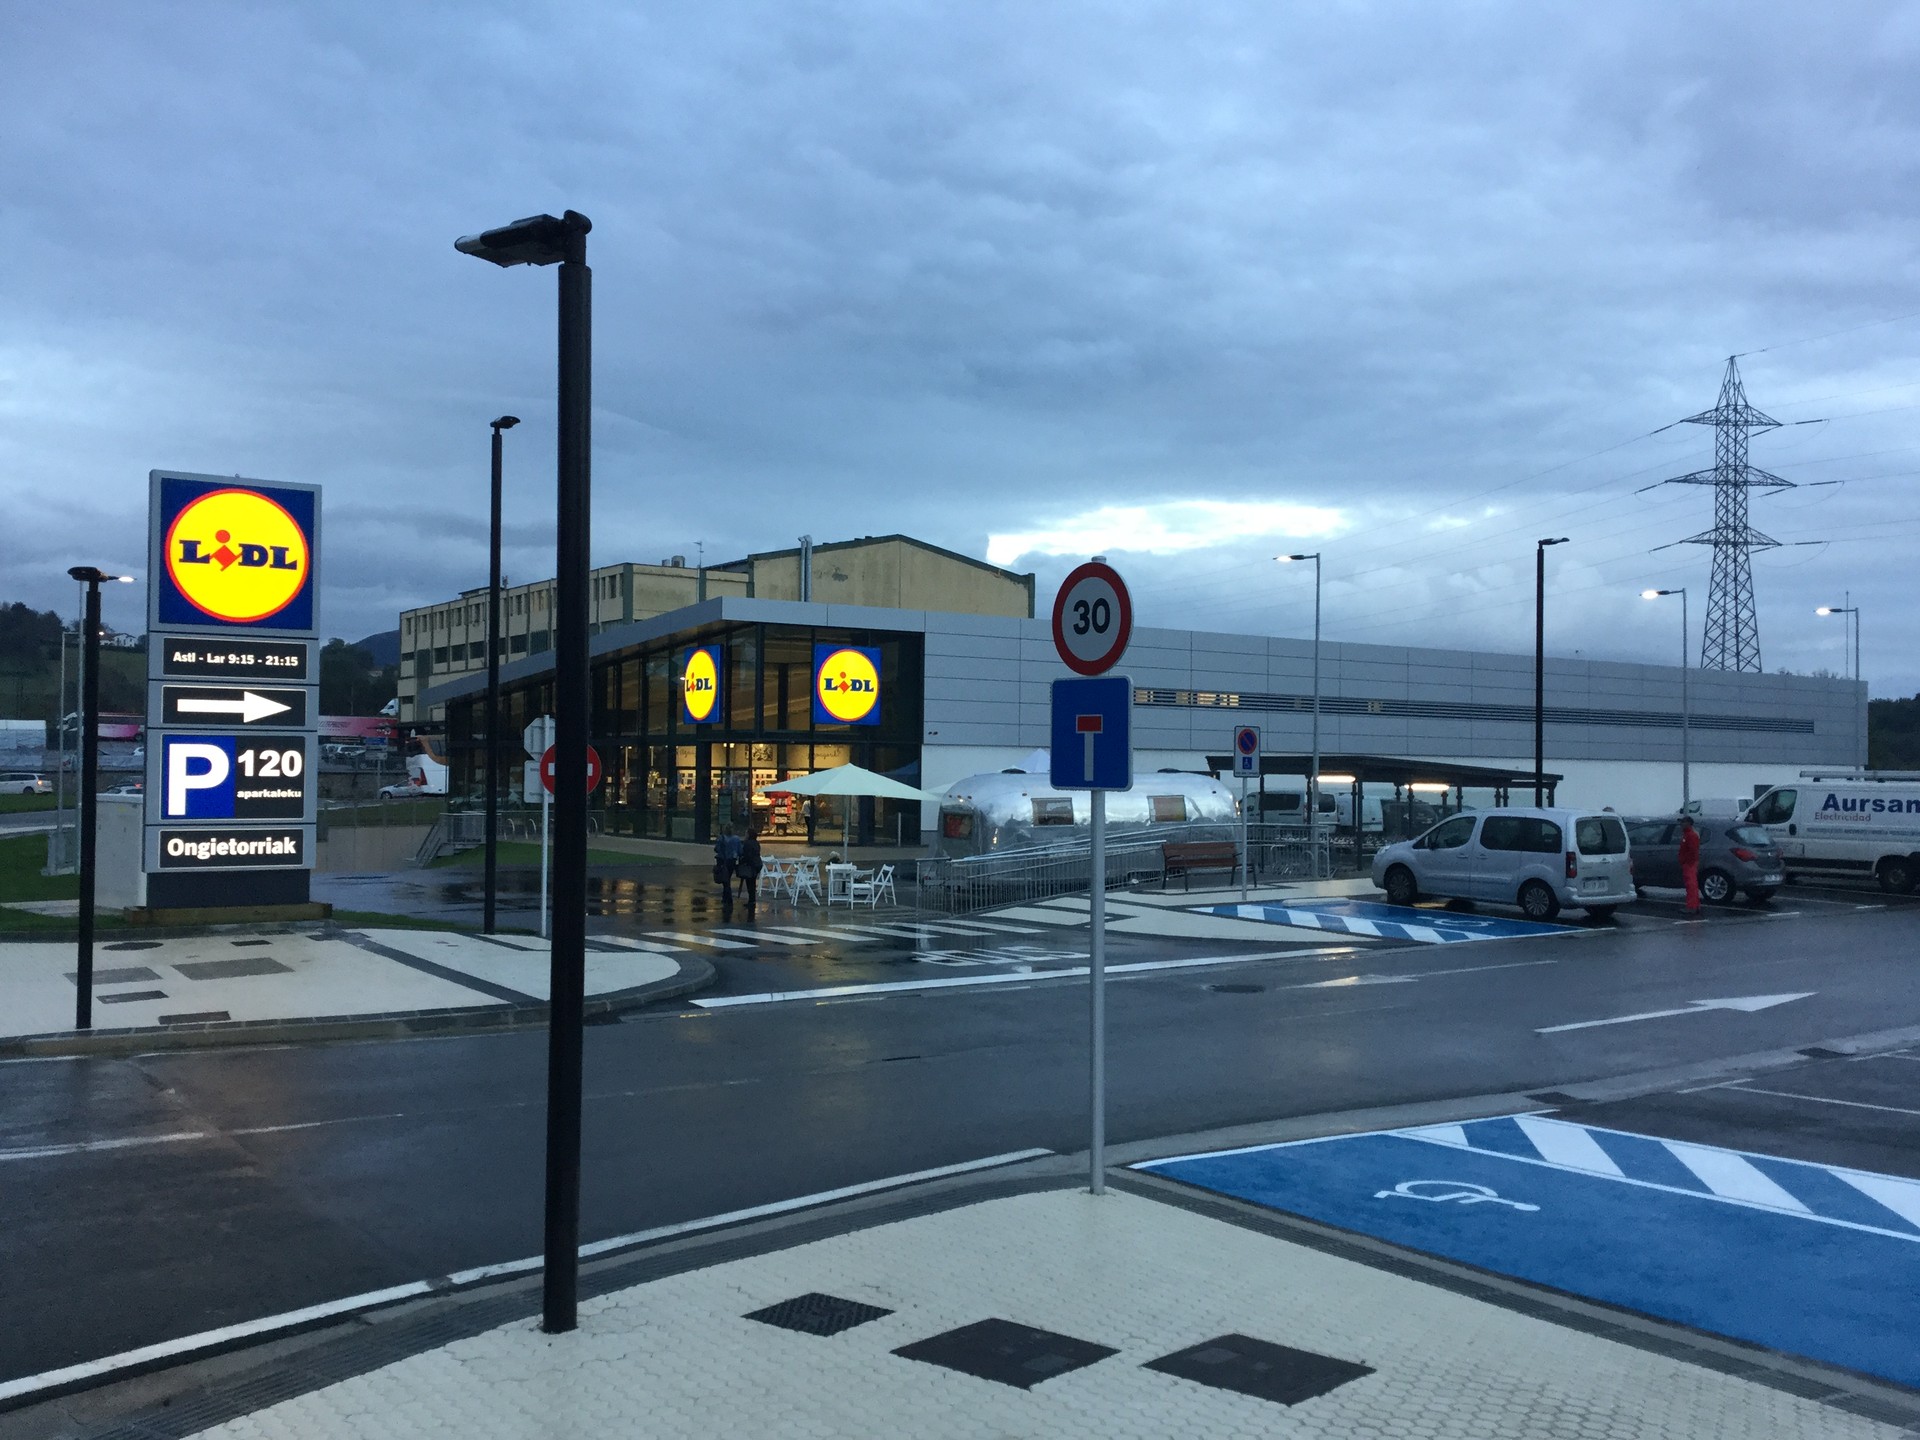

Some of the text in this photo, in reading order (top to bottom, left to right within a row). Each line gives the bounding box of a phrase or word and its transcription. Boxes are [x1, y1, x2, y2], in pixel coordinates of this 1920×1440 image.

[1073, 598, 1110, 635] 30
[206, 653, 225, 664] Lar
[228, 654, 254, 665] 9:15
[265, 656, 298, 667] 21:15
[168, 744, 302, 815] P 120
[237, 789, 302, 799] aparkaleku
[1822, 793, 1920, 813] Aursan
[1814, 811, 1871, 821] Electricidad
[167, 837, 296, 860] Ongietorriak
